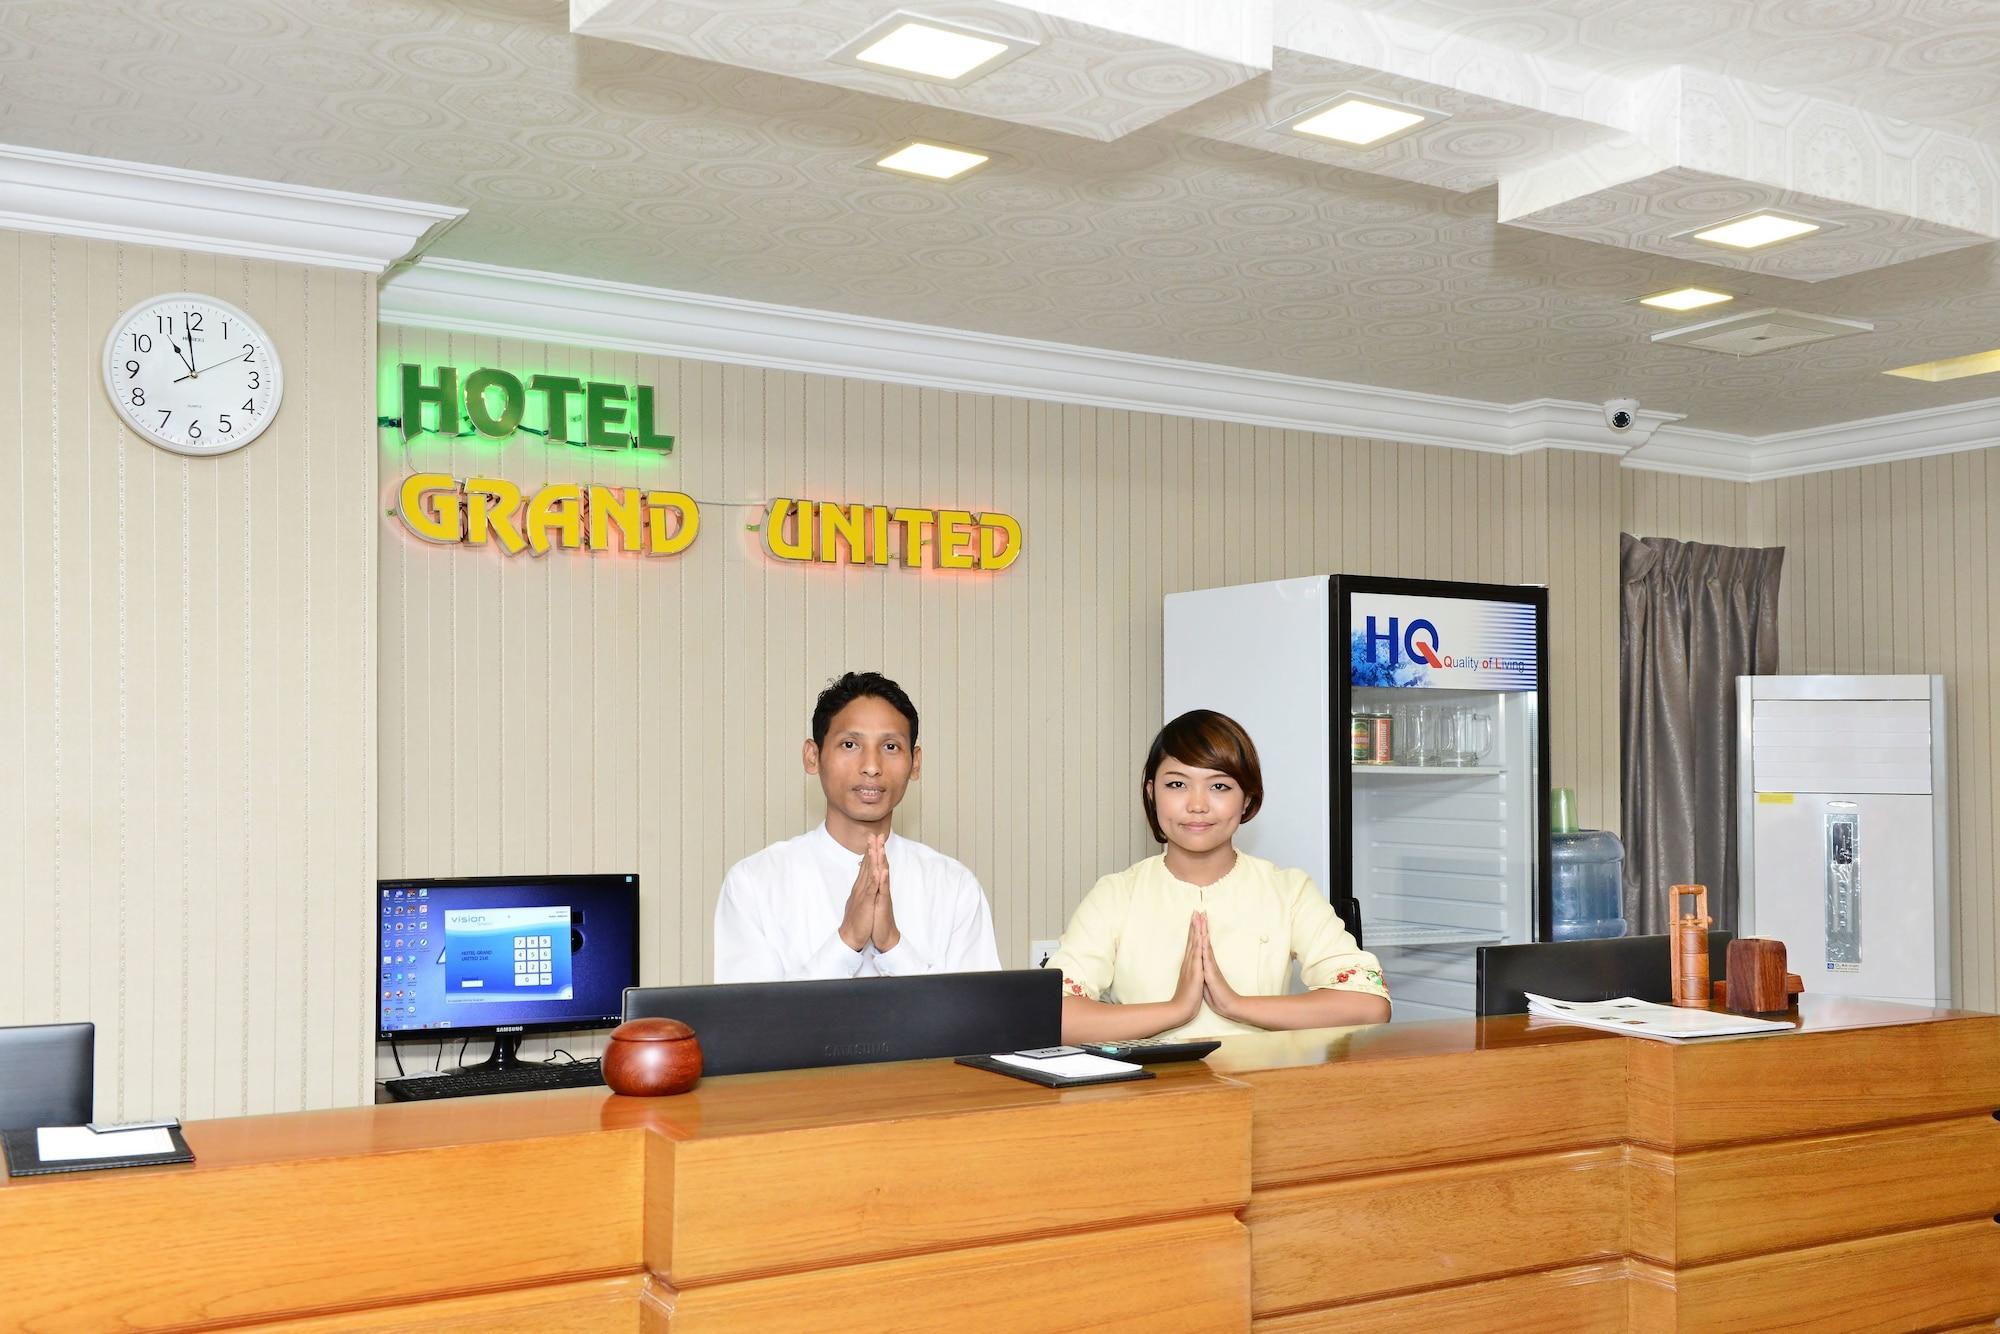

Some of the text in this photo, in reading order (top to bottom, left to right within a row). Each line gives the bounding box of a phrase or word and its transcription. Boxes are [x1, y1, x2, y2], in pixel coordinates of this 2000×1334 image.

[156, 315, 172, 335] 11
[183, 311, 203, 332] 12
[221, 321, 228, 340] 1
[131, 333, 152, 353] 10
[242, 343, 256, 363] 2
[125, 360, 140, 379] 9
[247, 371, 260, 390] 3
[131, 387, 146, 407] 8
[241, 397, 255, 415] 4
[157, 409, 172, 429] 7
[396, 362, 676, 456] HOTEL
[187, 419, 202, 439] 6
[218, 414, 233, 434] 5
[396, 472, 1023, 572] GRAND UNITED
[1366, 615, 1443, 669] HQ
[1443, 655, 1525, 674] Quality of Living
[451, 914, 486, 923] vision
[495, 1025, 524, 1033] SAMSUNG
